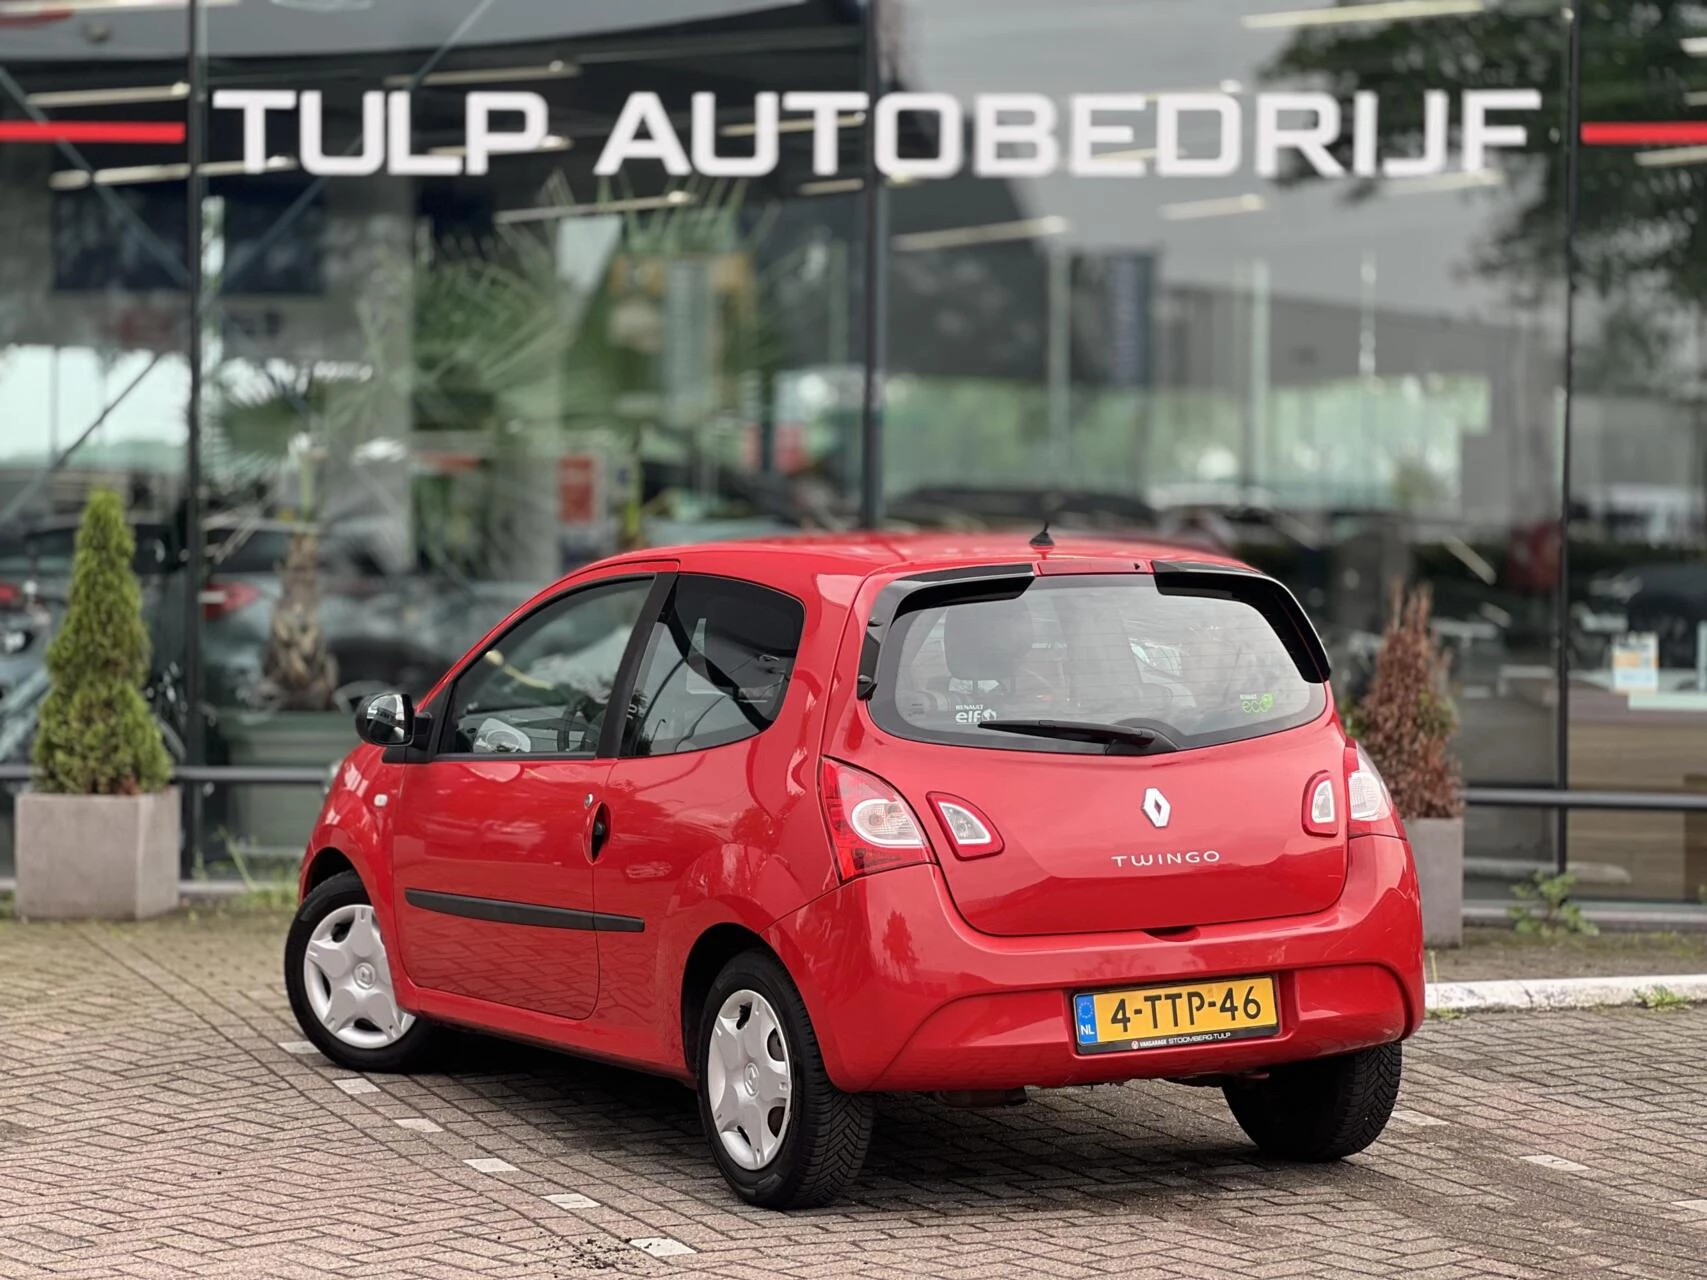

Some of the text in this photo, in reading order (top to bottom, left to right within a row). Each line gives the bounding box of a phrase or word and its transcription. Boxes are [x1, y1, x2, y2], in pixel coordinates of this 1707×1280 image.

[213, 89, 1542, 178] TULP AUTOBEDRIJF
[955, 710, 982, 723] elf
[1111, 850, 1220, 867] TWINGO
[1110, 985, 1262, 1033] 4-TTP-46
[1080, 1024, 1095, 1036] NL
